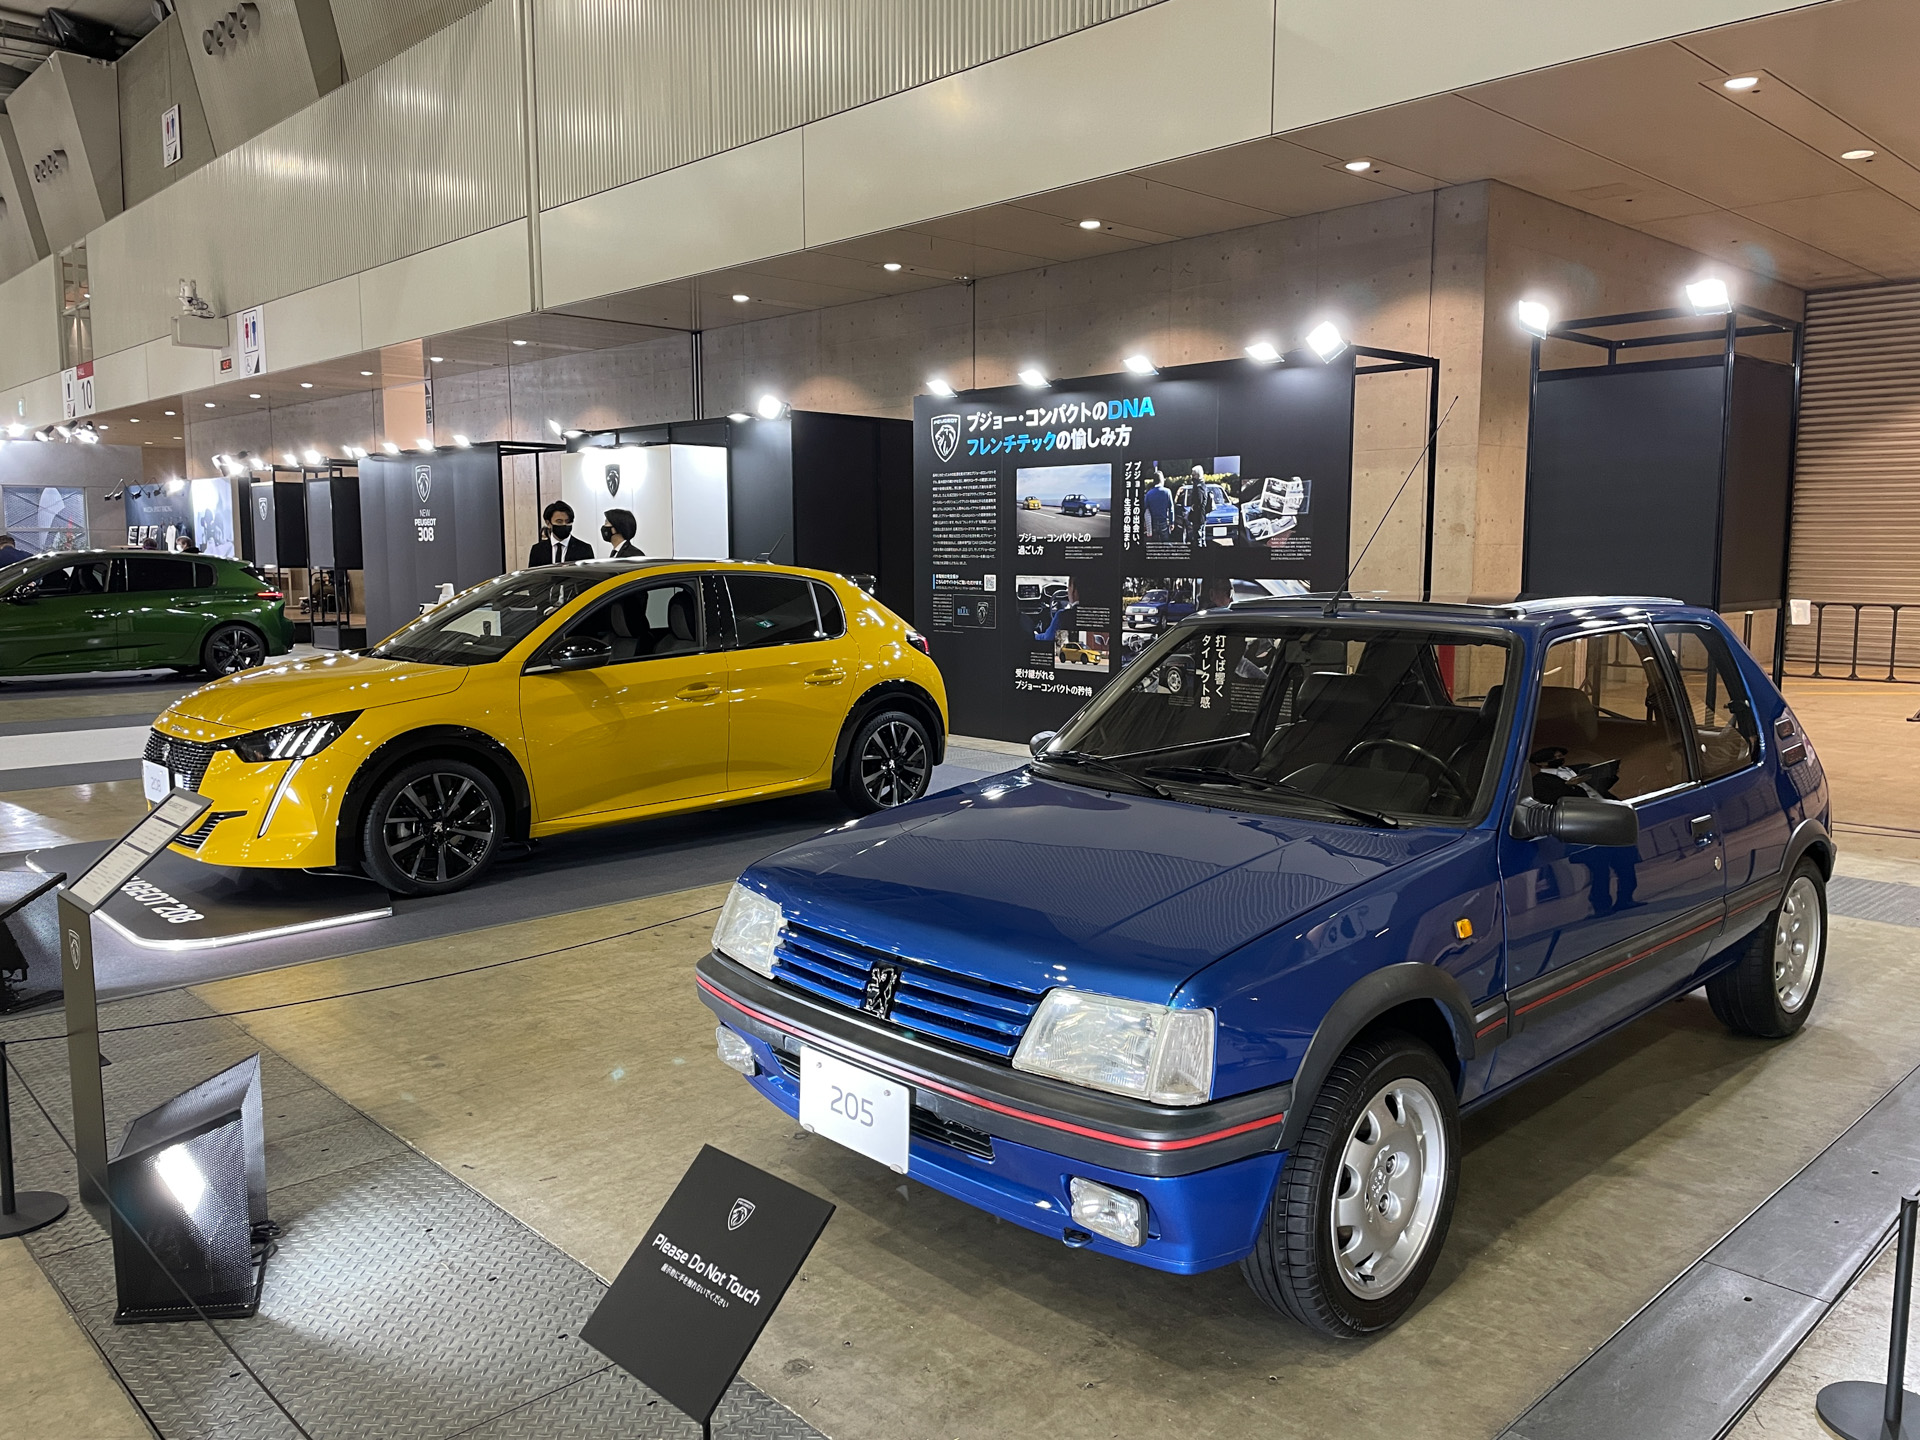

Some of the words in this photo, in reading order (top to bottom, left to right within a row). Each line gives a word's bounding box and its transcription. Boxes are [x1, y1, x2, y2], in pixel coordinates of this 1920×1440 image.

[81, 380, 93, 410] 10
[967, 396, 1156, 432] プジョー・コンパクトのDNA
[967, 423, 1133, 456] フレンチテックの愉しみ方
[419, 509, 431, 517] NEW
[1123, 461, 1133, 551] プジョー生活の始まり
[414, 518, 437, 527] PEUGEOT
[417, 527, 435, 542] 308
[1017, 545, 1044, 555] 過ごし方
[1018, 533, 1092, 543] プジョー・コンパクトとの
[1015, 668, 1055, 681] 受け継がれる
[1214, 635, 1227, 698] 打てば響く
[151, 903, 205, 924] 208
[830, 1085, 874, 1127] 205
[652, 1233, 689, 1264] Please
[687, 1253, 706, 1274] Do
[703, 1262, 727, 1287] Not
[725, 1274, 761, 1307] Touch
